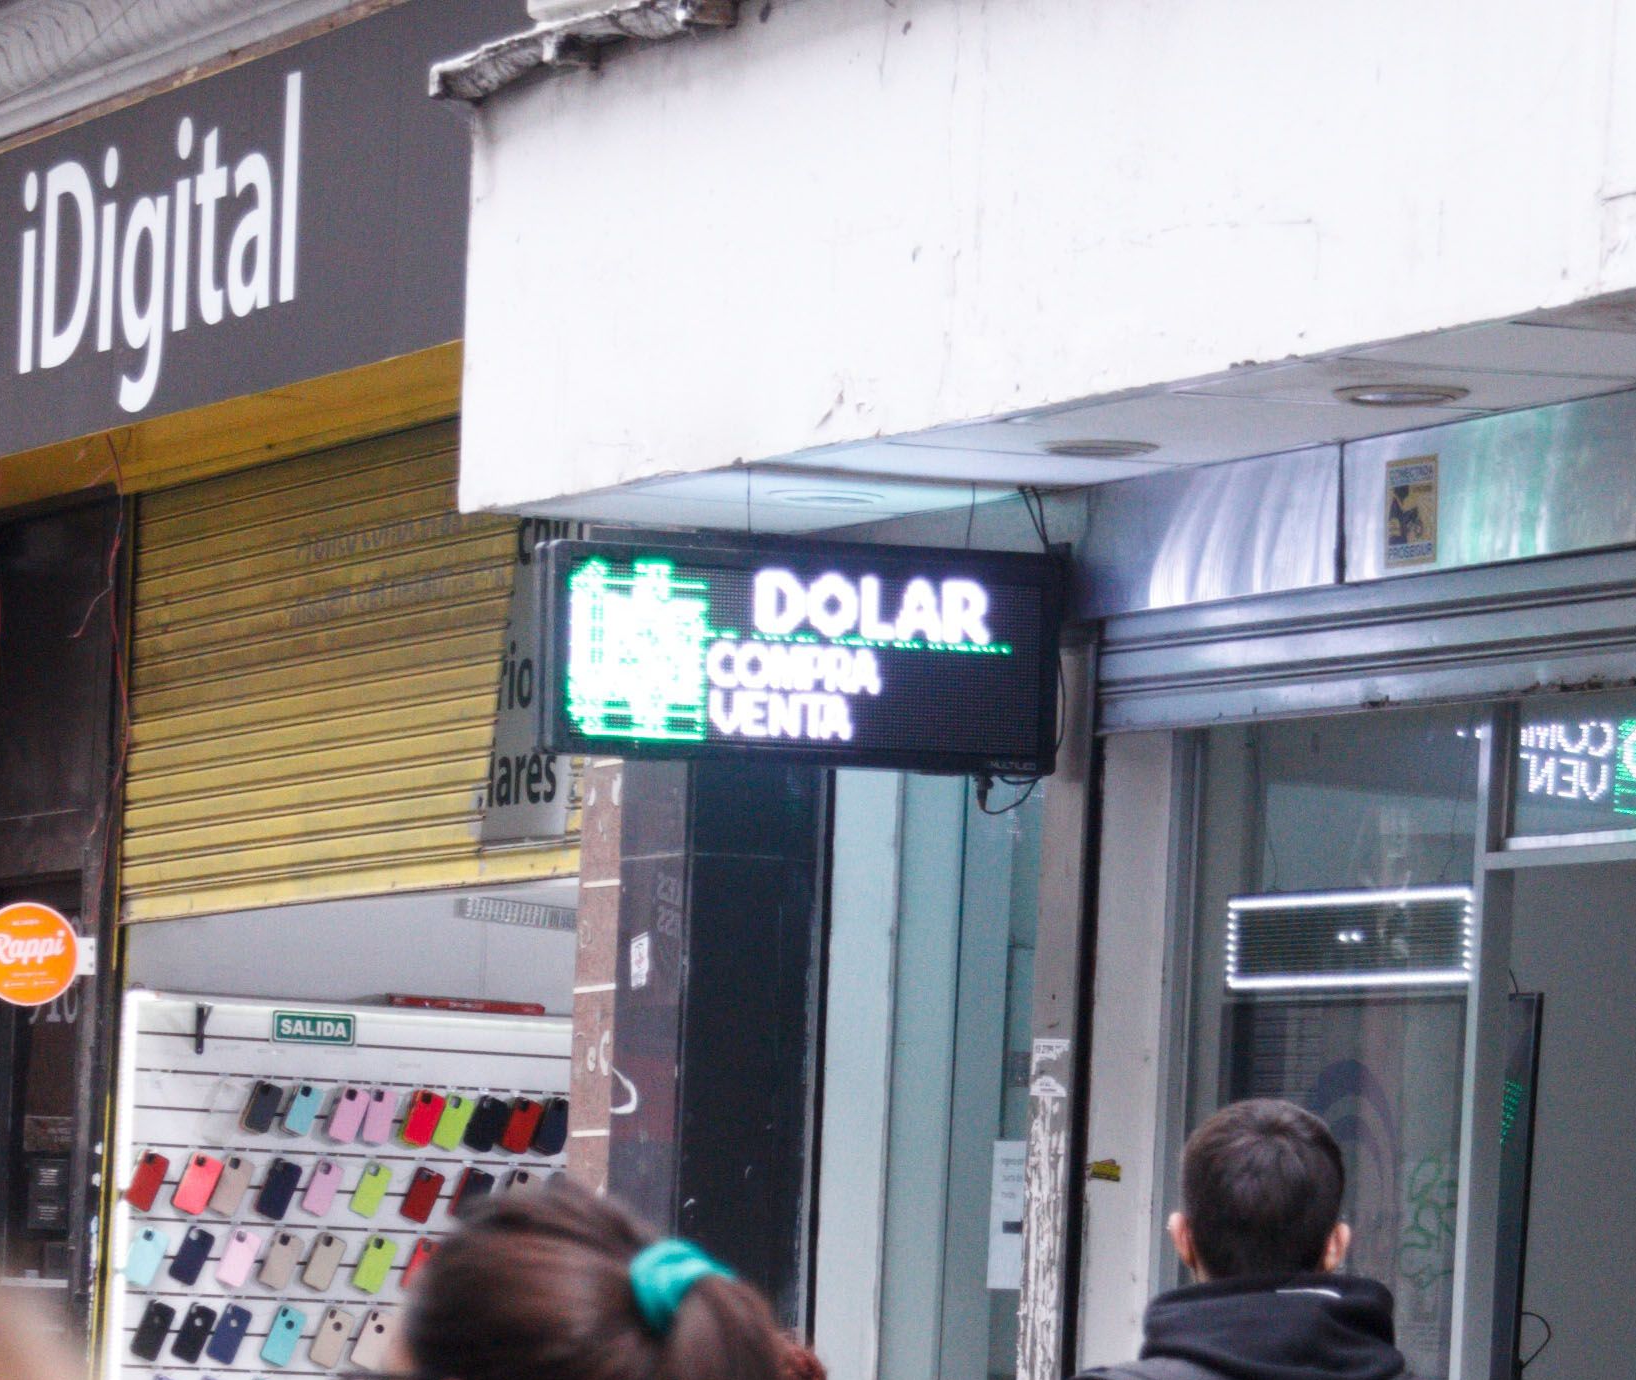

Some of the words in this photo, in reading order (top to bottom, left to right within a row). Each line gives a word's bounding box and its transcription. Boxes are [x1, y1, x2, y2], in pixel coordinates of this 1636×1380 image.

[18, 70, 303, 414] iDigital
[753, 567, 992, 645] DOLAR
[706, 641, 883, 697] COMPRA
[707, 689, 854, 742] VENTA
[280, 1018, 347, 1038] SALIDA
